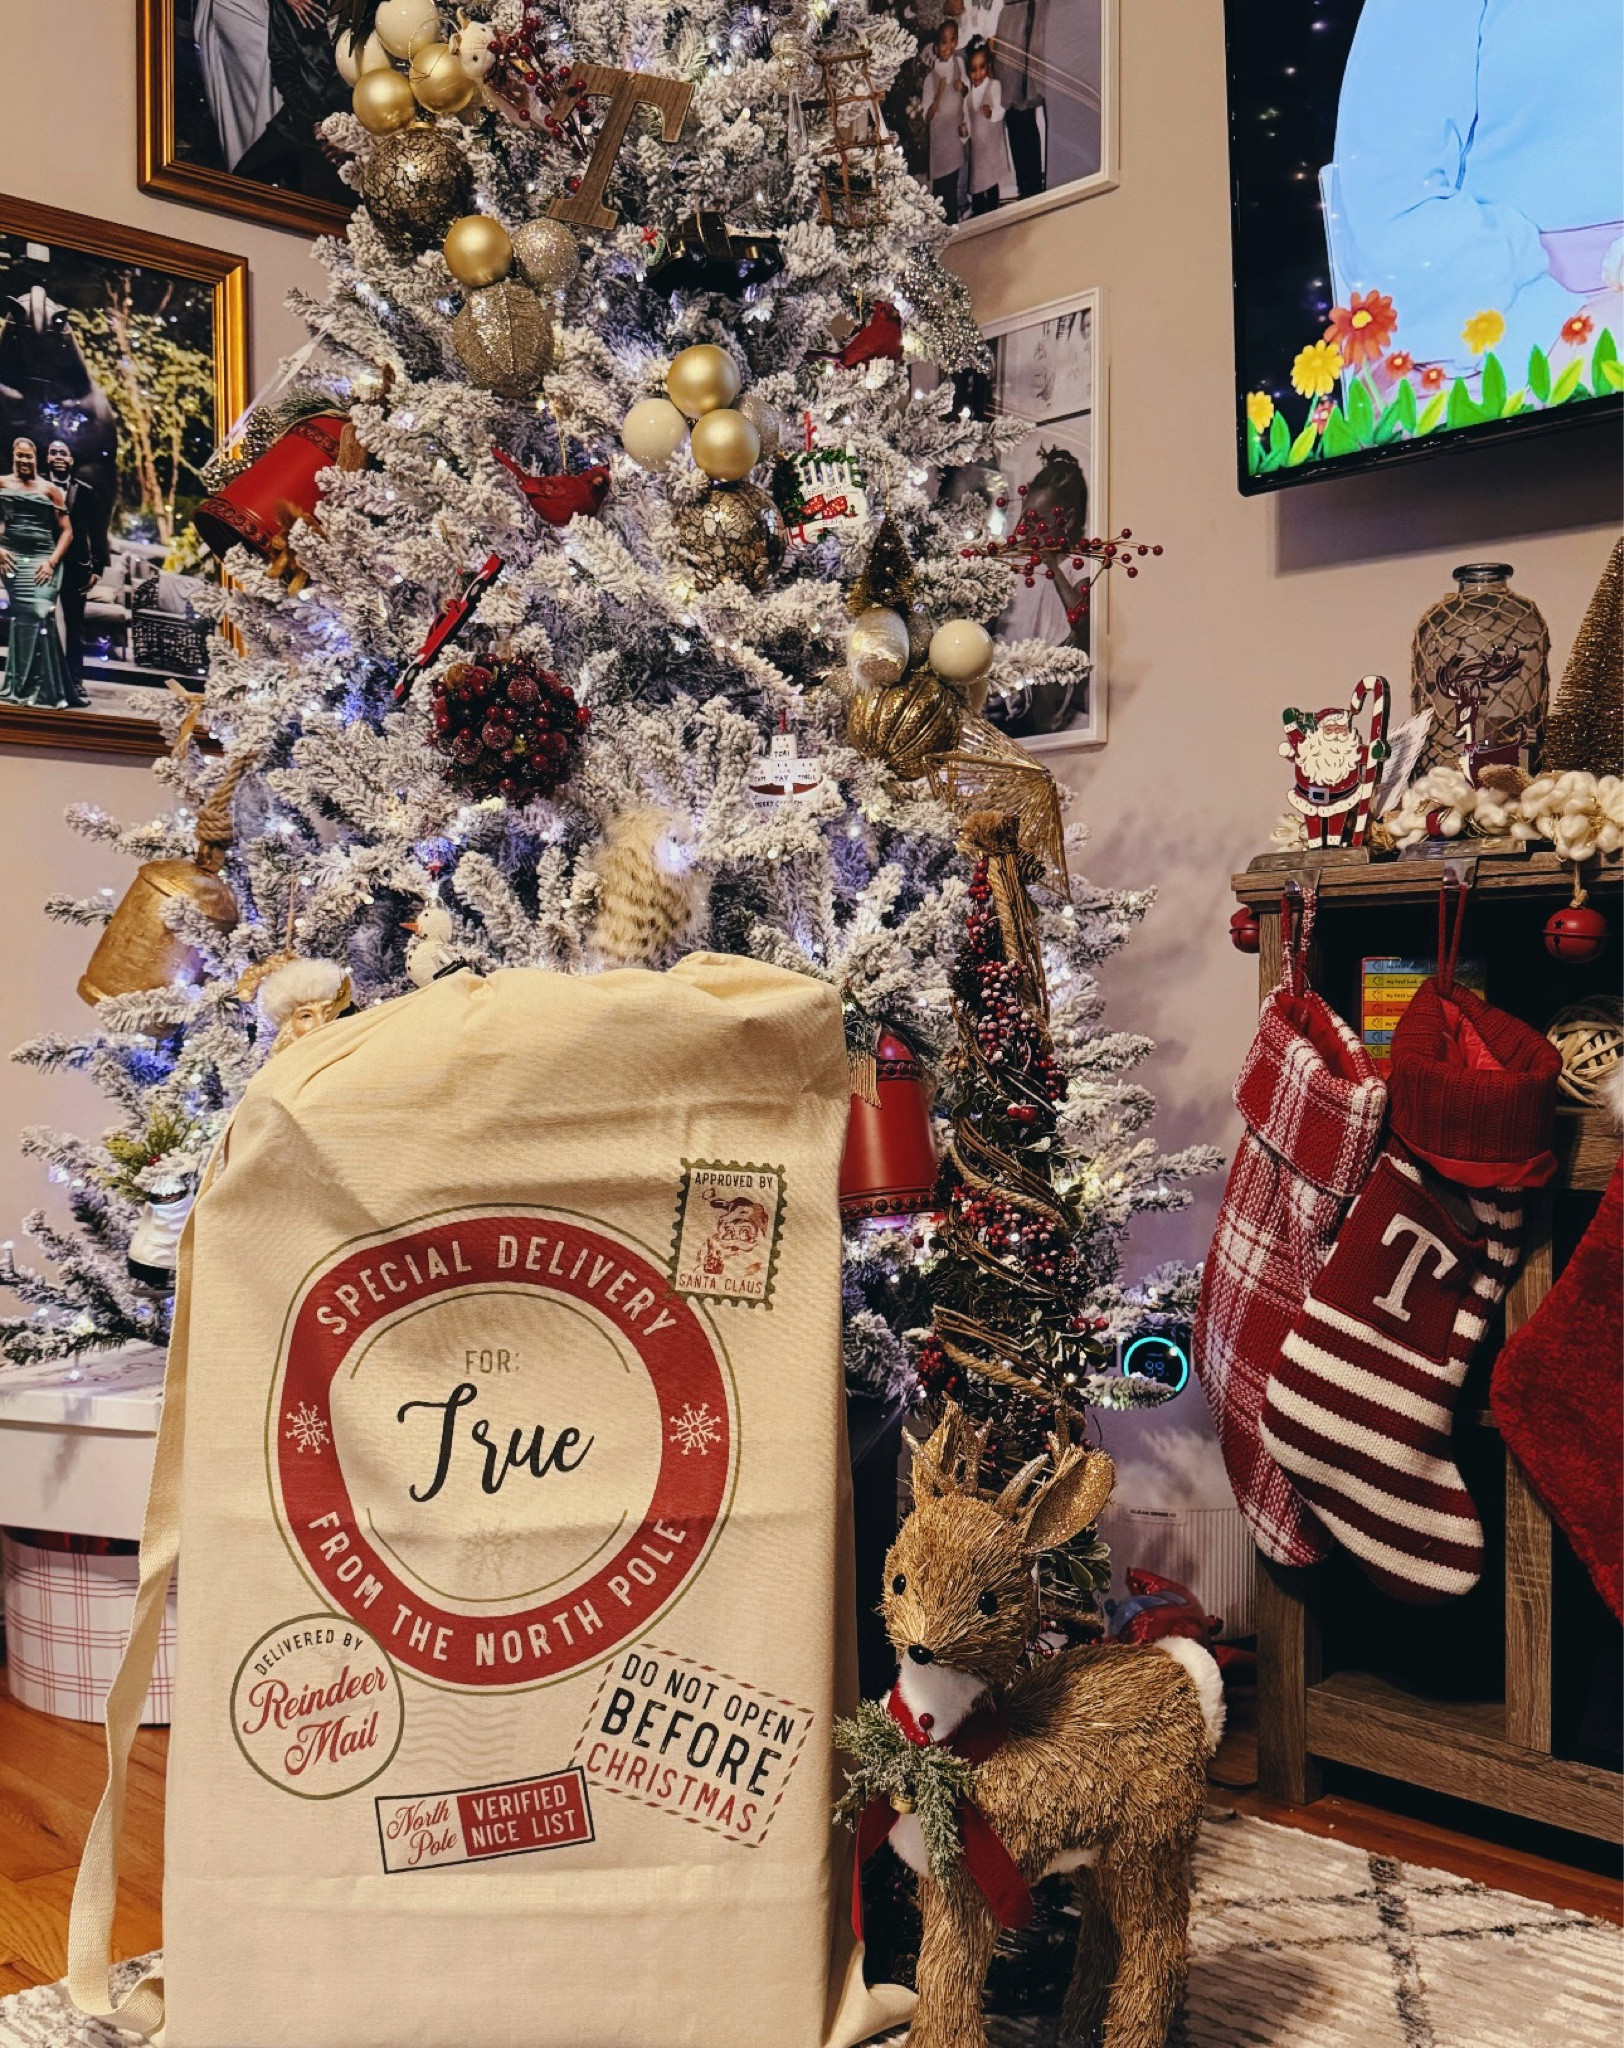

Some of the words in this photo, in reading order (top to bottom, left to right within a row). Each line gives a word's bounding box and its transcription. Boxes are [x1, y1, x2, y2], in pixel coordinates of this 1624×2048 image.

[546, 61, 696, 230] T
[694, 1171, 753, 1188] APPROVED
[759, 1176, 774, 1189] BY
[315, 1239, 472, 1336] SPECIAL
[497, 1234, 678, 1337] DELIVERY
[678, 1273, 716, 1290] SANTA
[724, 1278, 763, 1294] CLAUS
[1372, 1213, 1459, 1323] T
[464, 1348, 521, 1375] FOR:
[397, 1382, 595, 1503] True
[307, 1510, 384, 1610] FROM
[391, 1603, 454, 1662] THE
[474, 1598, 604, 1667] NORTH
[607, 1518, 687, 1608] POLE
[254, 1629, 334, 1676] DELIVERED
[343, 1632, 364, 1651] BY
[242, 1665, 389, 1734] Reindeer
[621, 1653, 659, 1688] DO
[663, 1668, 719, 1710] NOT
[723, 1694, 795, 1745] OPEN
[284, 1711, 379, 1776] Mail
[600, 1687, 783, 1797] BEFORE
[386, 1799, 451, 1840] North
[471, 1784, 568, 1821] VERIFIED
[586, 1742, 758, 1833] CHRISTMAS
[407, 1829, 459, 1866] Pole
[470, 1822, 517, 1848] NICE
[531, 1809, 577, 1839] LIST
